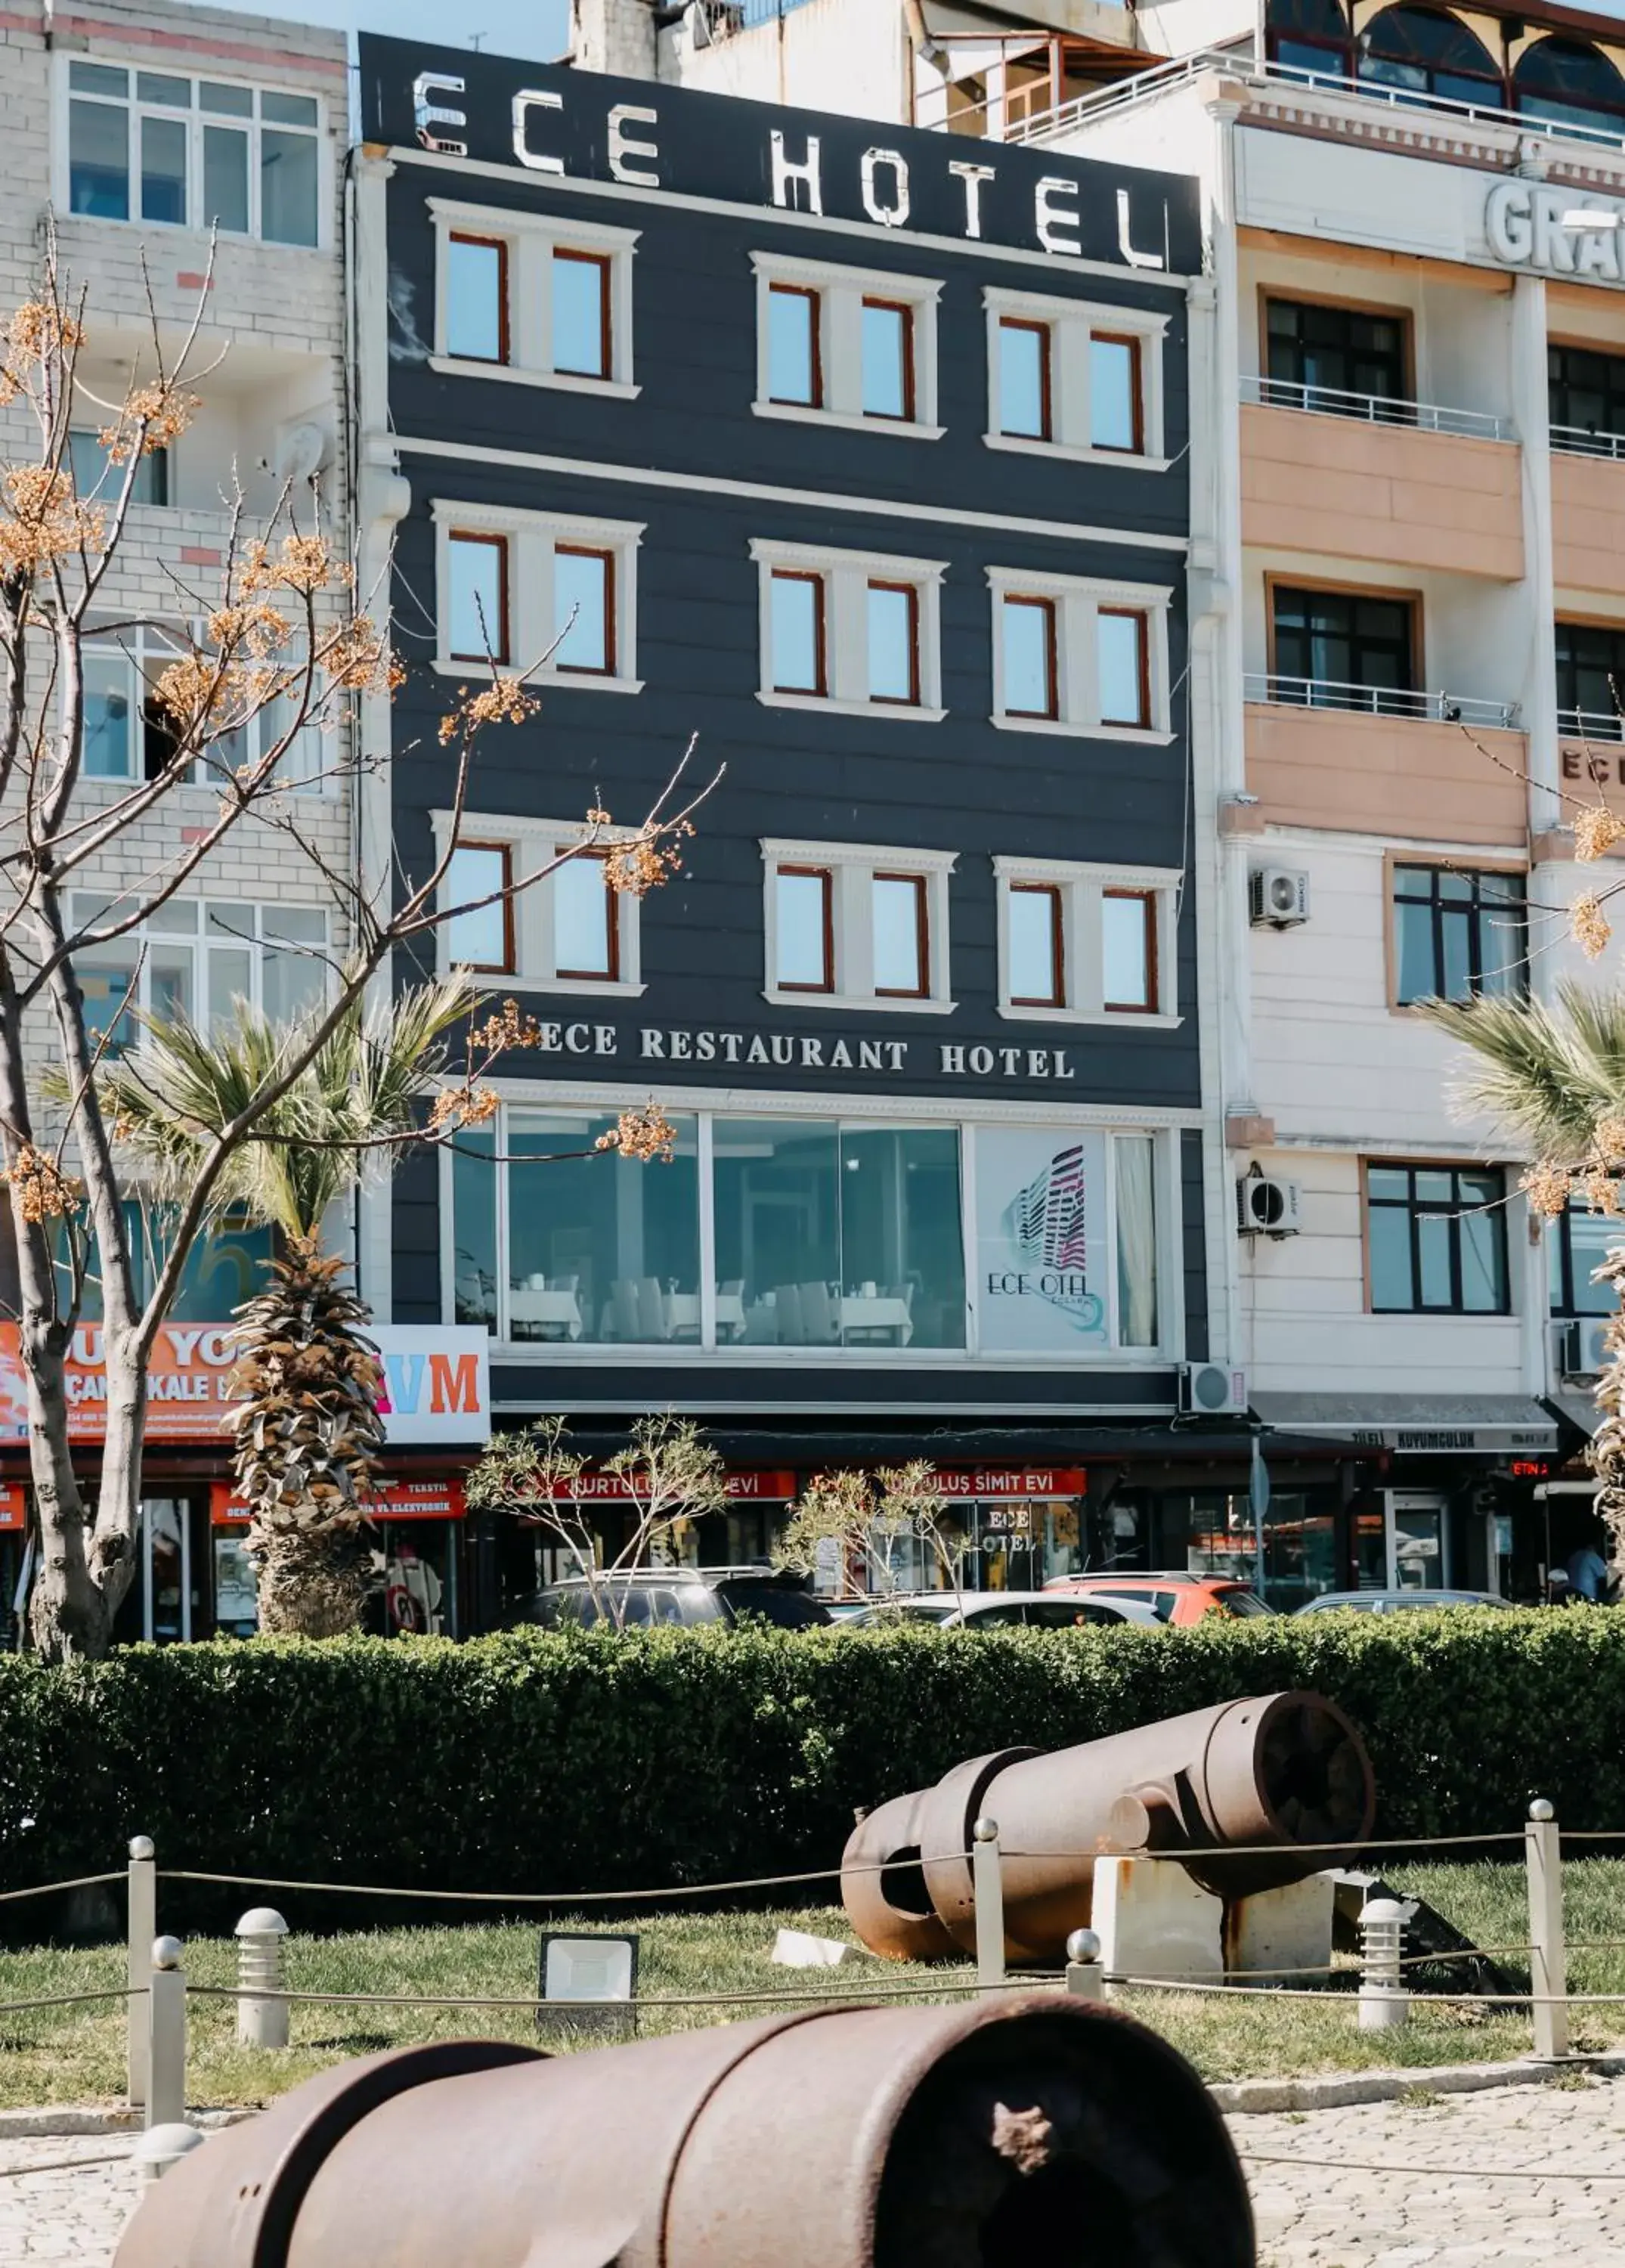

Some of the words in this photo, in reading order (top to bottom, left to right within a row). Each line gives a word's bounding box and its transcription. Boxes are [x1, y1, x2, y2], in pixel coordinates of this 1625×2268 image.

[413, 70, 661, 188] ECE
[770, 129, 1165, 270] HOTEL
[1485, 184, 1625, 282] GRA
[539, 1023, 618, 1055] ECE
[640, 1028, 907, 1070] RESTAURANT
[940, 1045, 1076, 1078] HOTEL
[988, 1273, 1030, 1295] ECE
[1041, 1273, 1094, 1297] OTEL
[975, 1473, 1020, 1492] SİMİT
[1026, 1472, 1053, 1491] EVİ
[989, 1510, 1029, 1528] ECE
[983, 1535, 1036, 1553] OTEL
